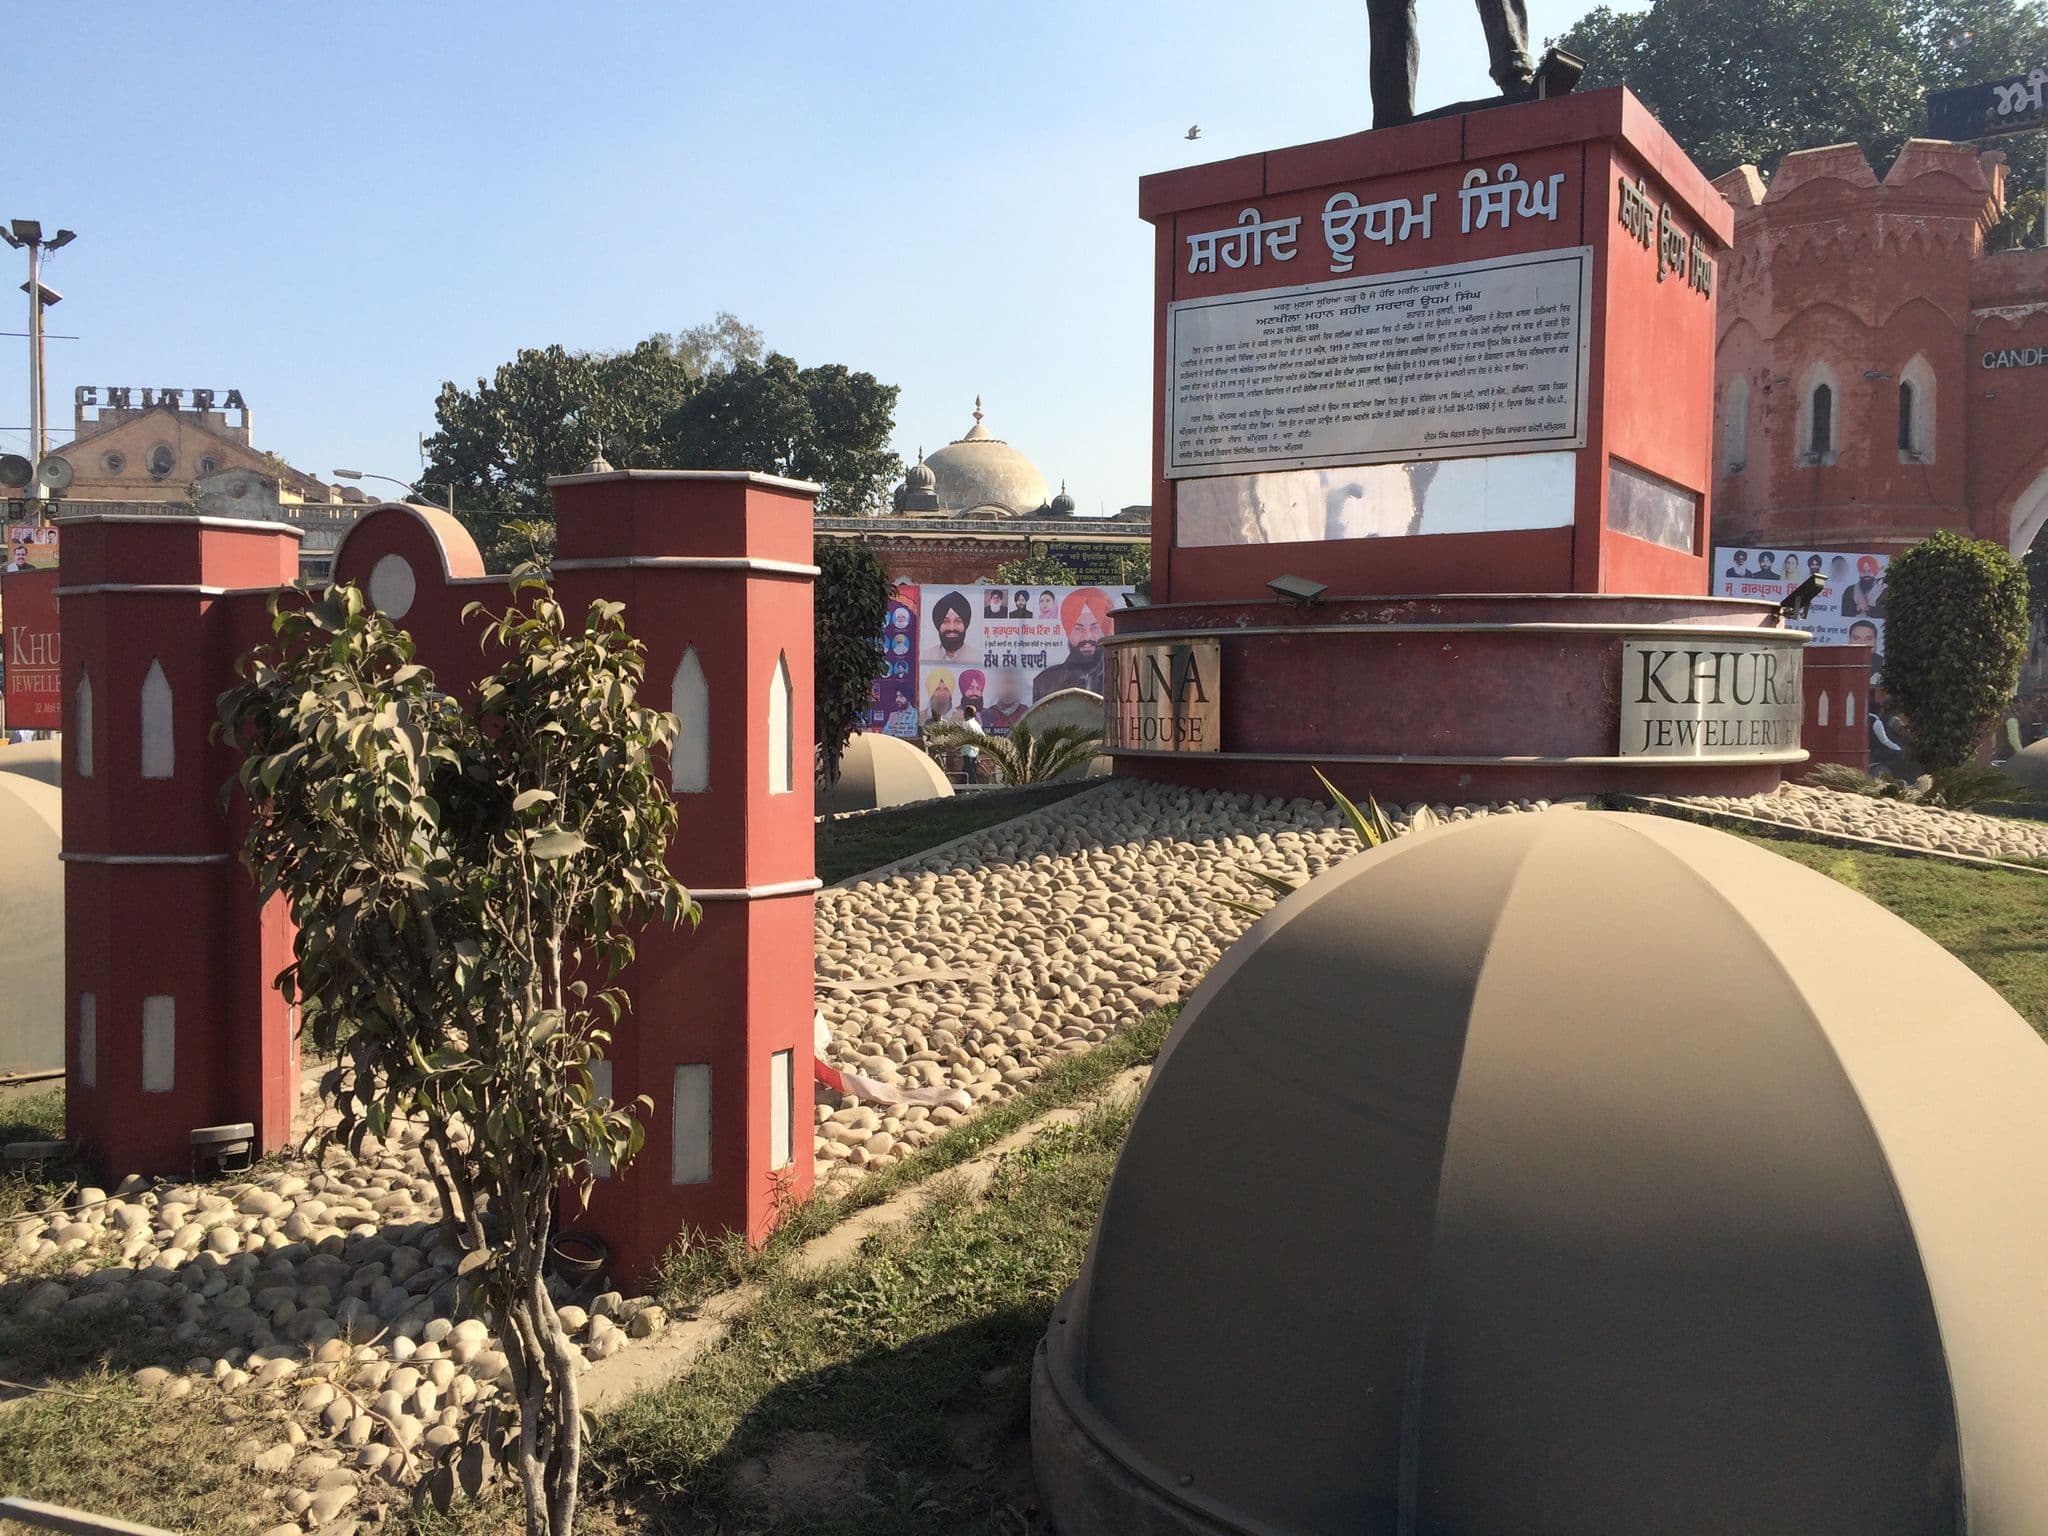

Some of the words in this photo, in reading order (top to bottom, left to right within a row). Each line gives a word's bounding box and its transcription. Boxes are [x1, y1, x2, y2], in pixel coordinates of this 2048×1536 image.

[1187, 207, 1302, 274] ਸ਼ਹੀਦ
[1321, 192, 1437, 273] ਊਧਮ
[1459, 163, 1565, 234] ਸਿੰਘ
[1256, 313, 1300, 325] ਅਣਖੀਲਾ
[1304, 309, 1334, 320] ਮਹਾਨ
[1339, 304, 1370, 316] ਸ਼ਹੀਦ
[1375, 299, 1415, 311] ਸਰਦਾਰ
[1420, 295, 1449, 309] ਊਧਮ
[1455, 289, 1481, 302] ਸਿੰਘ
[1458, 304, 1472, 312] 1940
[1442, 356, 1456, 365] 1940
[1383, 375, 1397, 384] 1940
[75, 386, 248, 409] CHITRA
[1456, 401, 1490, 412] 26-12-1990
[11, 626, 60, 665] KHU
[12, 674, 60, 694] JEWELLE
[1635, 649, 1800, 706] KHURA
[1130, 716, 1204, 743] HOUSE
[1641, 719, 1778, 752] JEWELLERY
